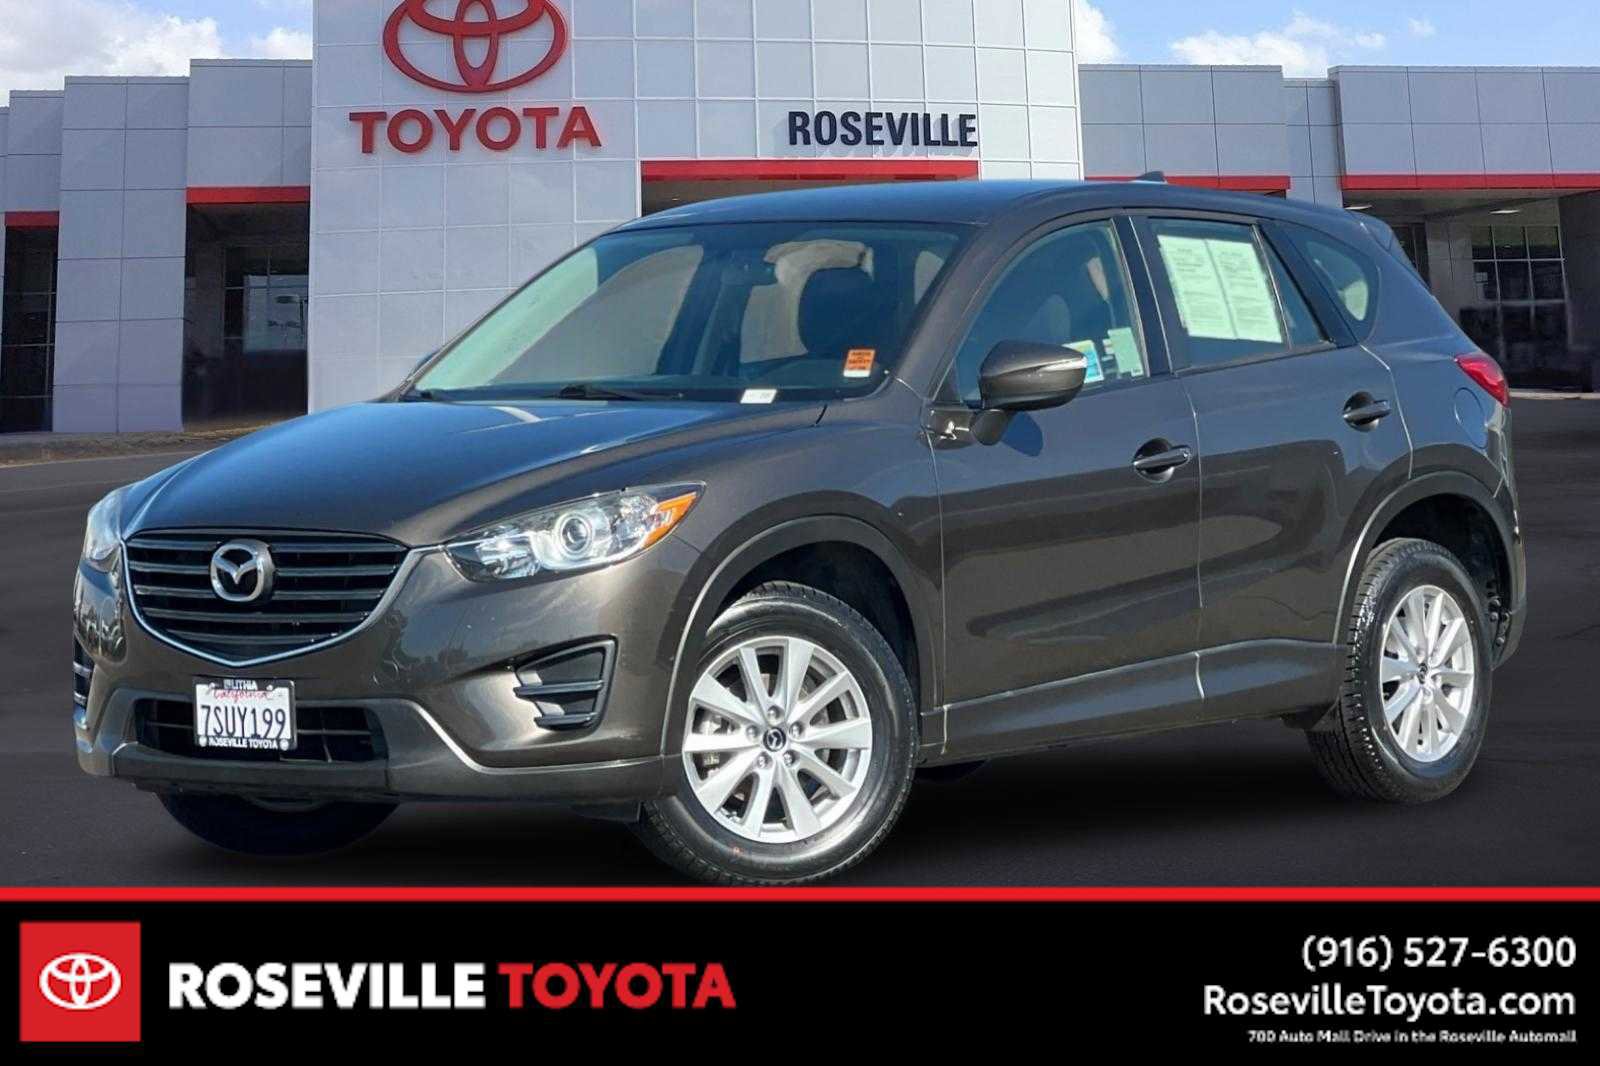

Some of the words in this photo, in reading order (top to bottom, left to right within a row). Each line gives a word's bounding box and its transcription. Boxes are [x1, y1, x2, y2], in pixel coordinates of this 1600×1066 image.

[349, 106, 602, 154] TOYOTA
[788, 111, 979, 147] ROSEVILLE
[201, 705, 286, 738] 7SUY199
[208, 736, 248, 748] ROSEVILLE
[249, 739, 279, 749] TOYOTA
